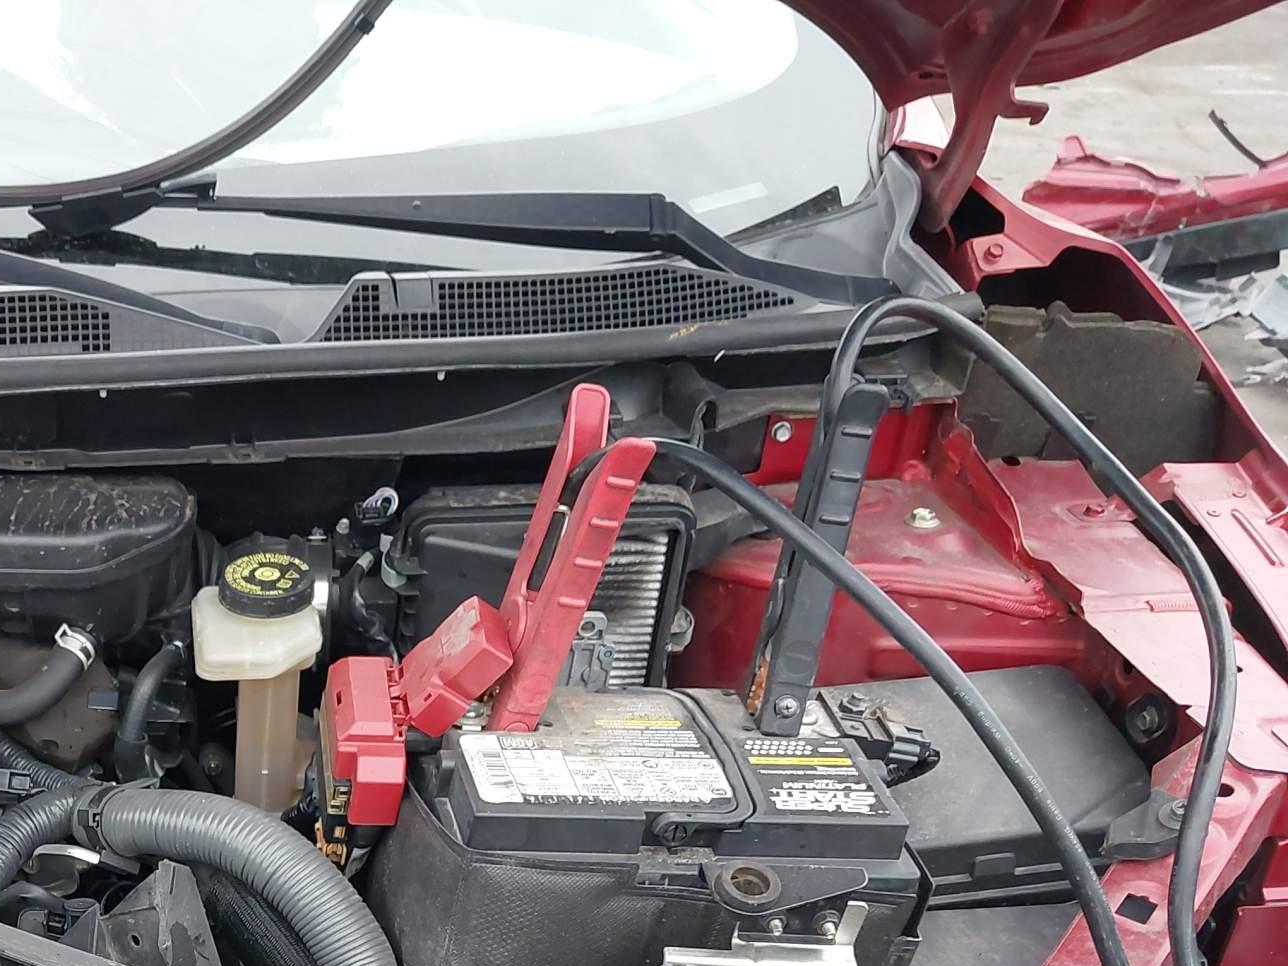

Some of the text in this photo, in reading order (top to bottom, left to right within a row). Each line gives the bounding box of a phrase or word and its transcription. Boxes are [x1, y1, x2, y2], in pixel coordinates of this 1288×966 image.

[783, 781, 868, 790] PLATINUM
[774, 789, 876, 804] START
[775, 799, 871, 813] SUPER
